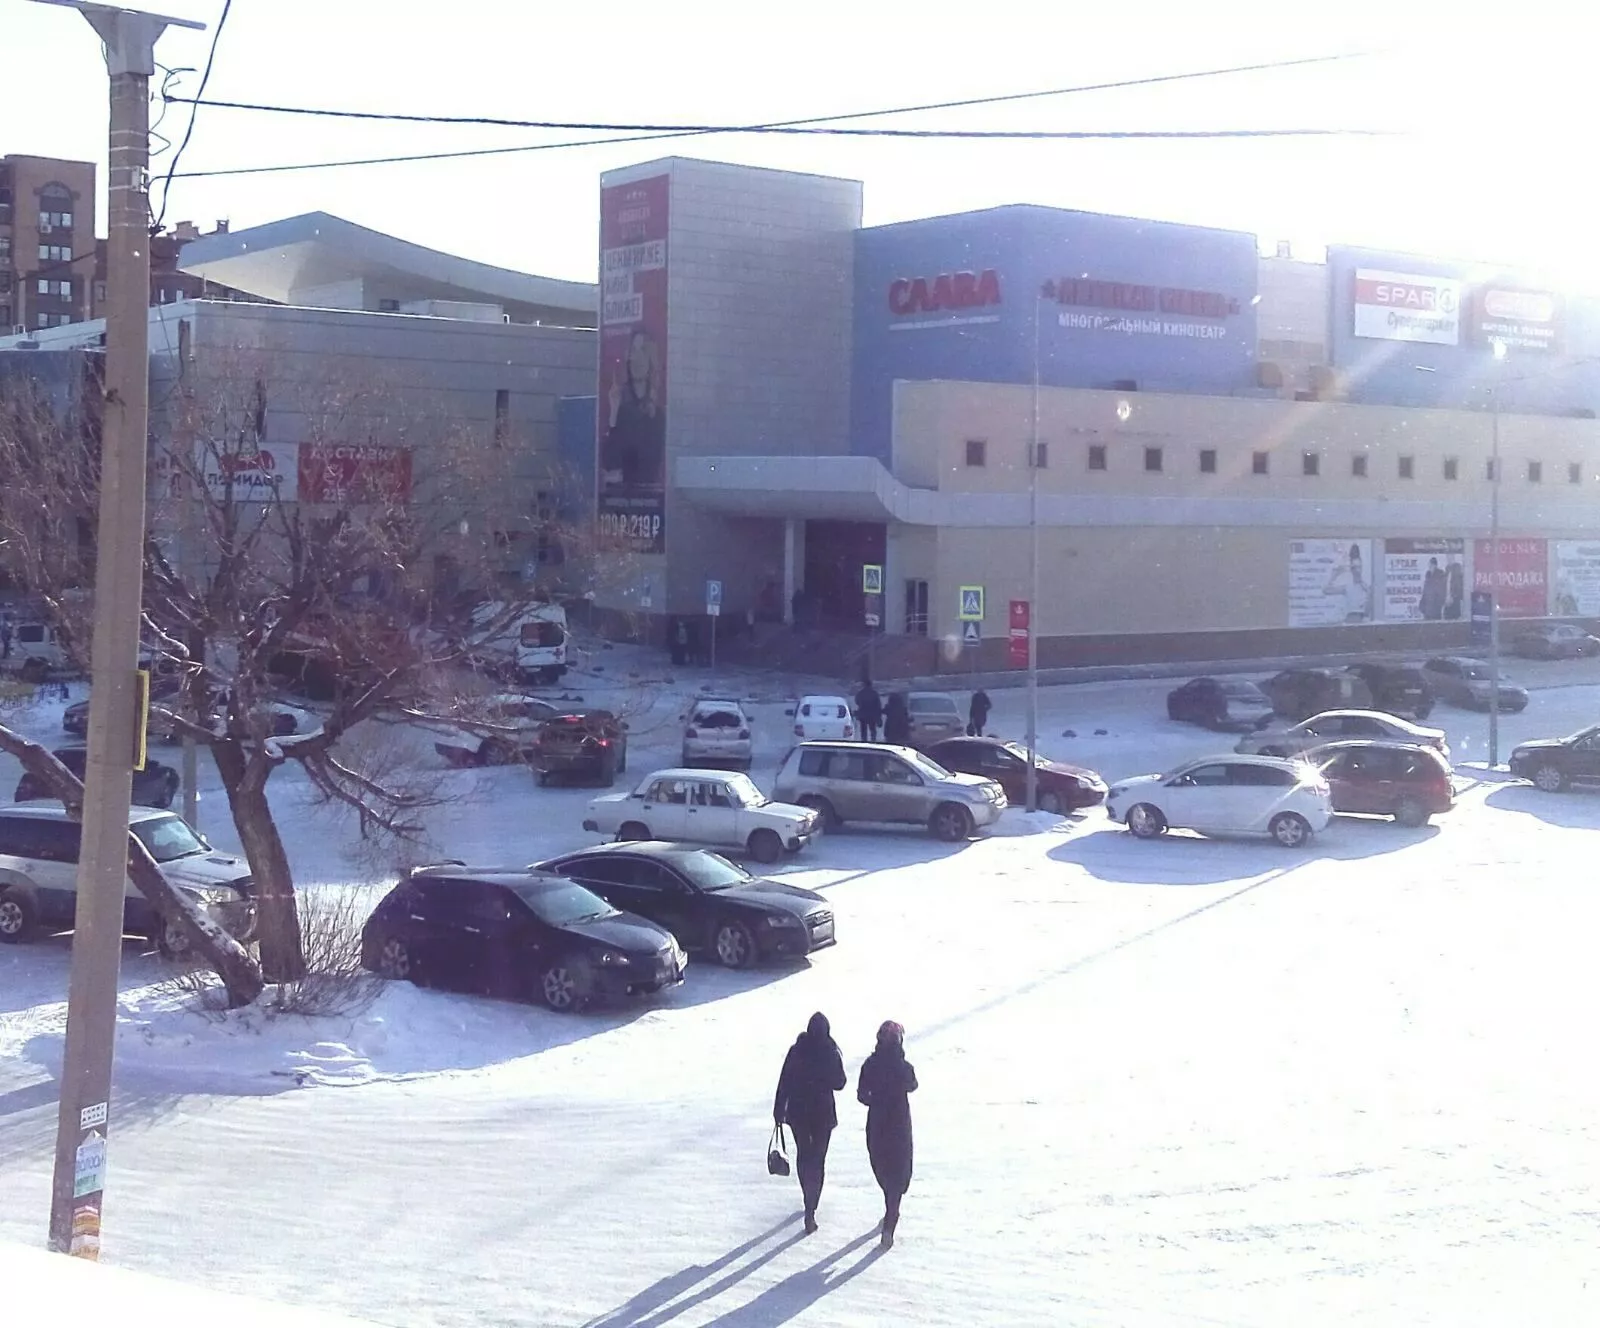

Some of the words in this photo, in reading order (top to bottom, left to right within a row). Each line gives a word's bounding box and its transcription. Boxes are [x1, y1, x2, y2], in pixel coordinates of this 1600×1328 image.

[889, 268, 1001, 314] СЛАВА
[1376, 285, 1435, 309] SPAR
[1163, 323, 1227, 339] КИНОТЕАТР
[1483, 543, 1539, 554] SOLNIK
[1476, 571, 1544, 588] РАСПРОДАЖА
